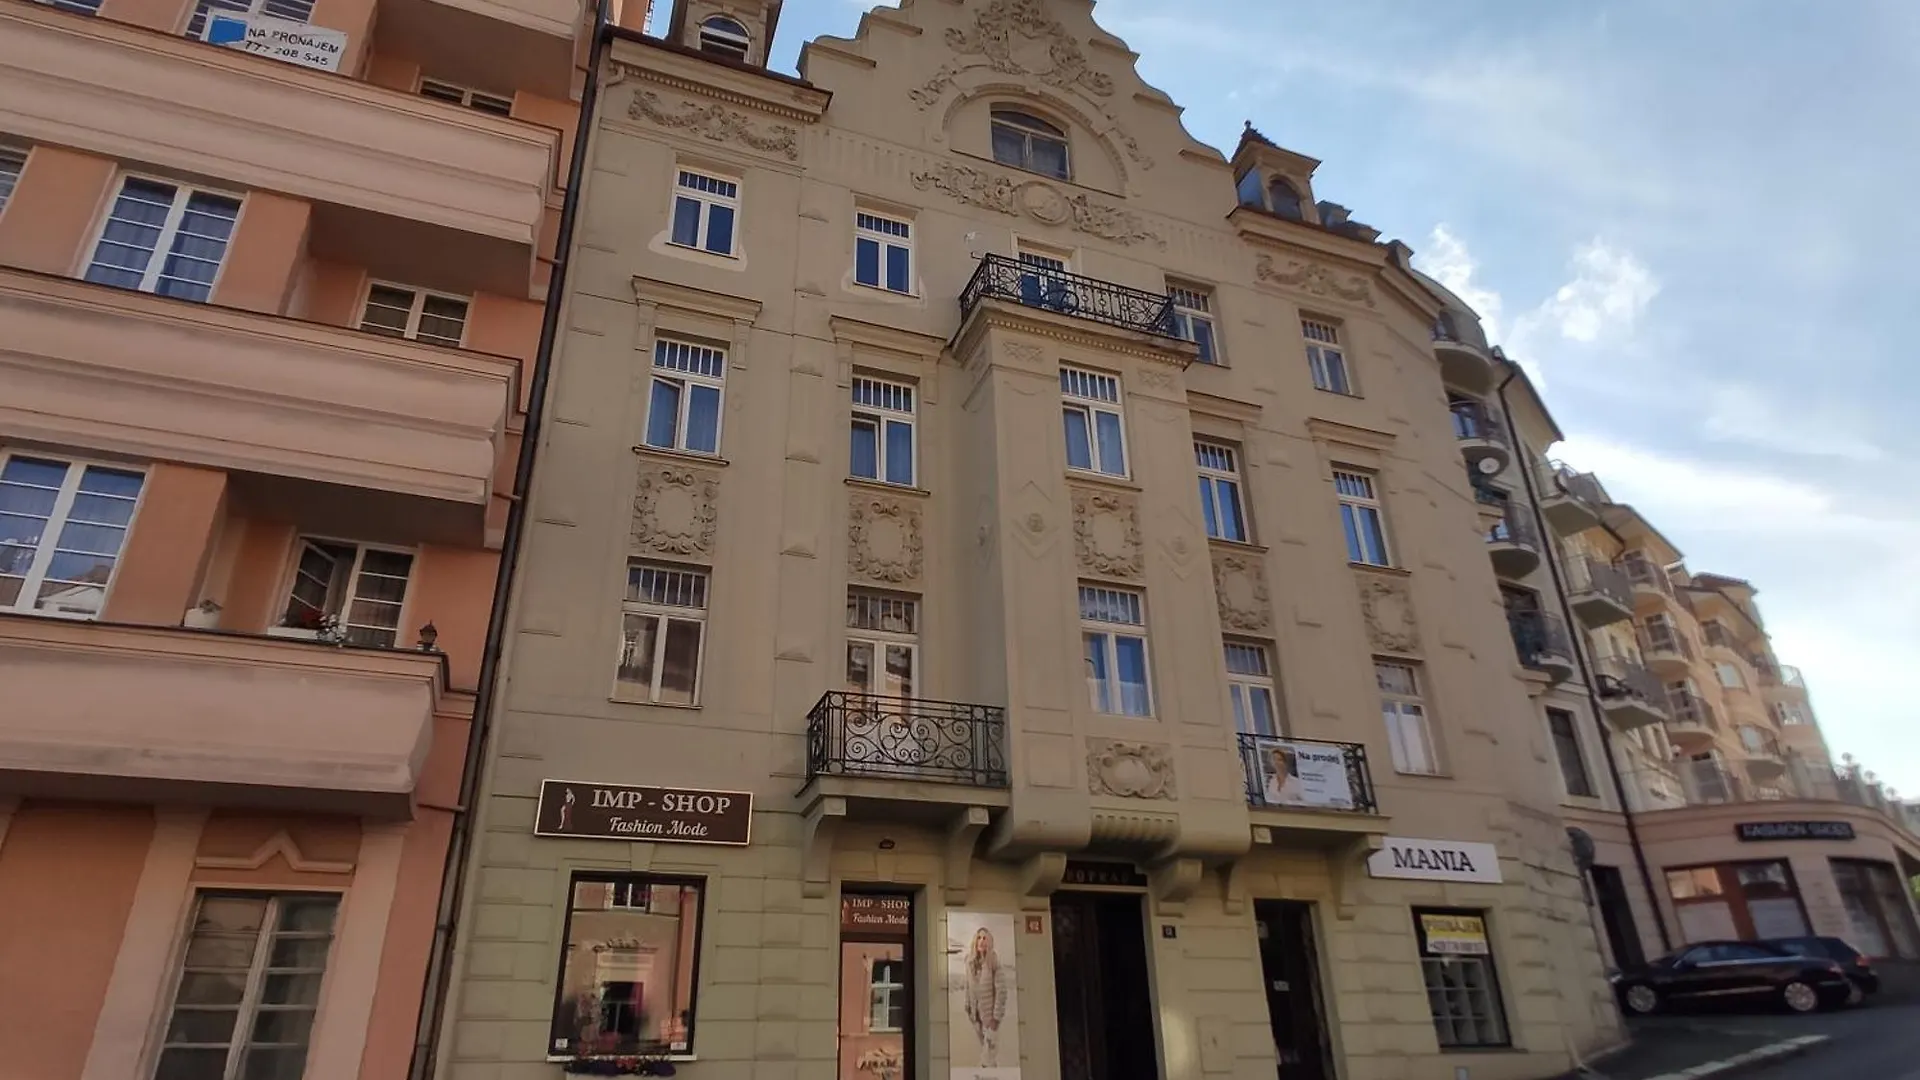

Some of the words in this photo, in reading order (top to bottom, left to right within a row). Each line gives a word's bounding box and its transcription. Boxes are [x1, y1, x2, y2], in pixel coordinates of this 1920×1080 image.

[248, 27, 266, 38] NA
[274, 47, 299, 58] 208
[1298, 751, 1311, 761] Na
[591, 789, 643, 809] IMP
[661, 793, 731, 815] SHOP
[609, 816, 664, 835] Fashion
[666, 819, 709, 837] Mode
[1392, 847, 1476, 872] MANIA
[852, 898, 873, 908] IMP
[881, 899, 910, 910] SHOP
[852, 912, 884, 924] Fashion
